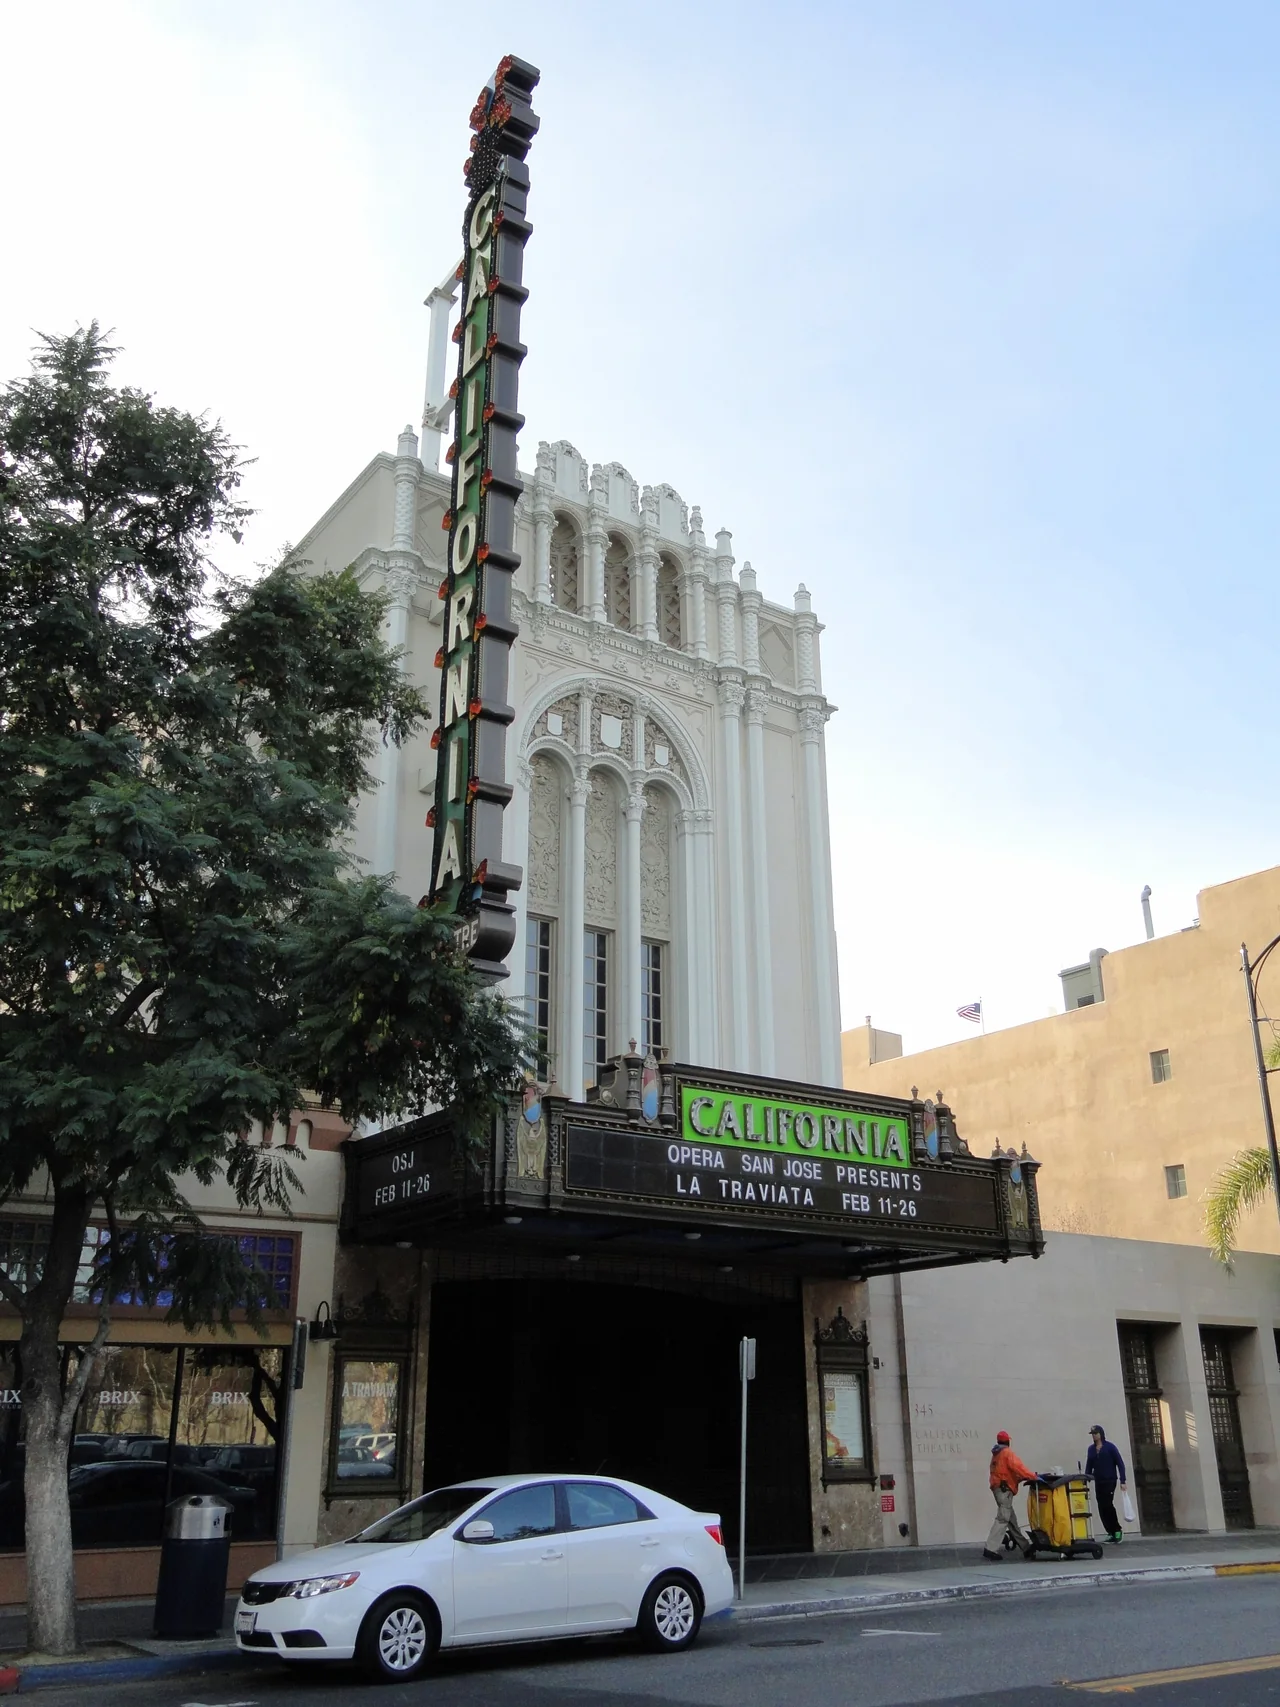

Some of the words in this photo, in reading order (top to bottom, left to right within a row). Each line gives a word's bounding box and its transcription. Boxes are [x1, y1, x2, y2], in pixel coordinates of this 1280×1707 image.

[435, 190, 494, 891] CALIFORNIA
[689, 1096, 906, 1161] CALIFORNIA
[392, 1150, 414, 1173] OSJ
[667, 1144, 725, 1169] OPERA
[741, 1154, 774, 1175] SAN
[783, 1159, 823, 1181] JOSE
[836, 1165, 922, 1192] PRESENTS
[375, 1184, 396, 1206] FEB
[401, 1173, 430, 1198] 11-26
[676, 1174, 701, 1195] LA
[718, 1179, 814, 1206] TRAVIATA
[842, 1192, 870, 1212] FEB
[877, 1197, 917, 1217] 11-26
[99, 1390, 141, 1404] BRIX
[211, 1391, 250, 1404] BRIX
[915, 1403, 934, 1417] 345
[915, 1428, 981, 1440] CALIFORNIA
[916, 1442, 963, 1455] THEATRE
